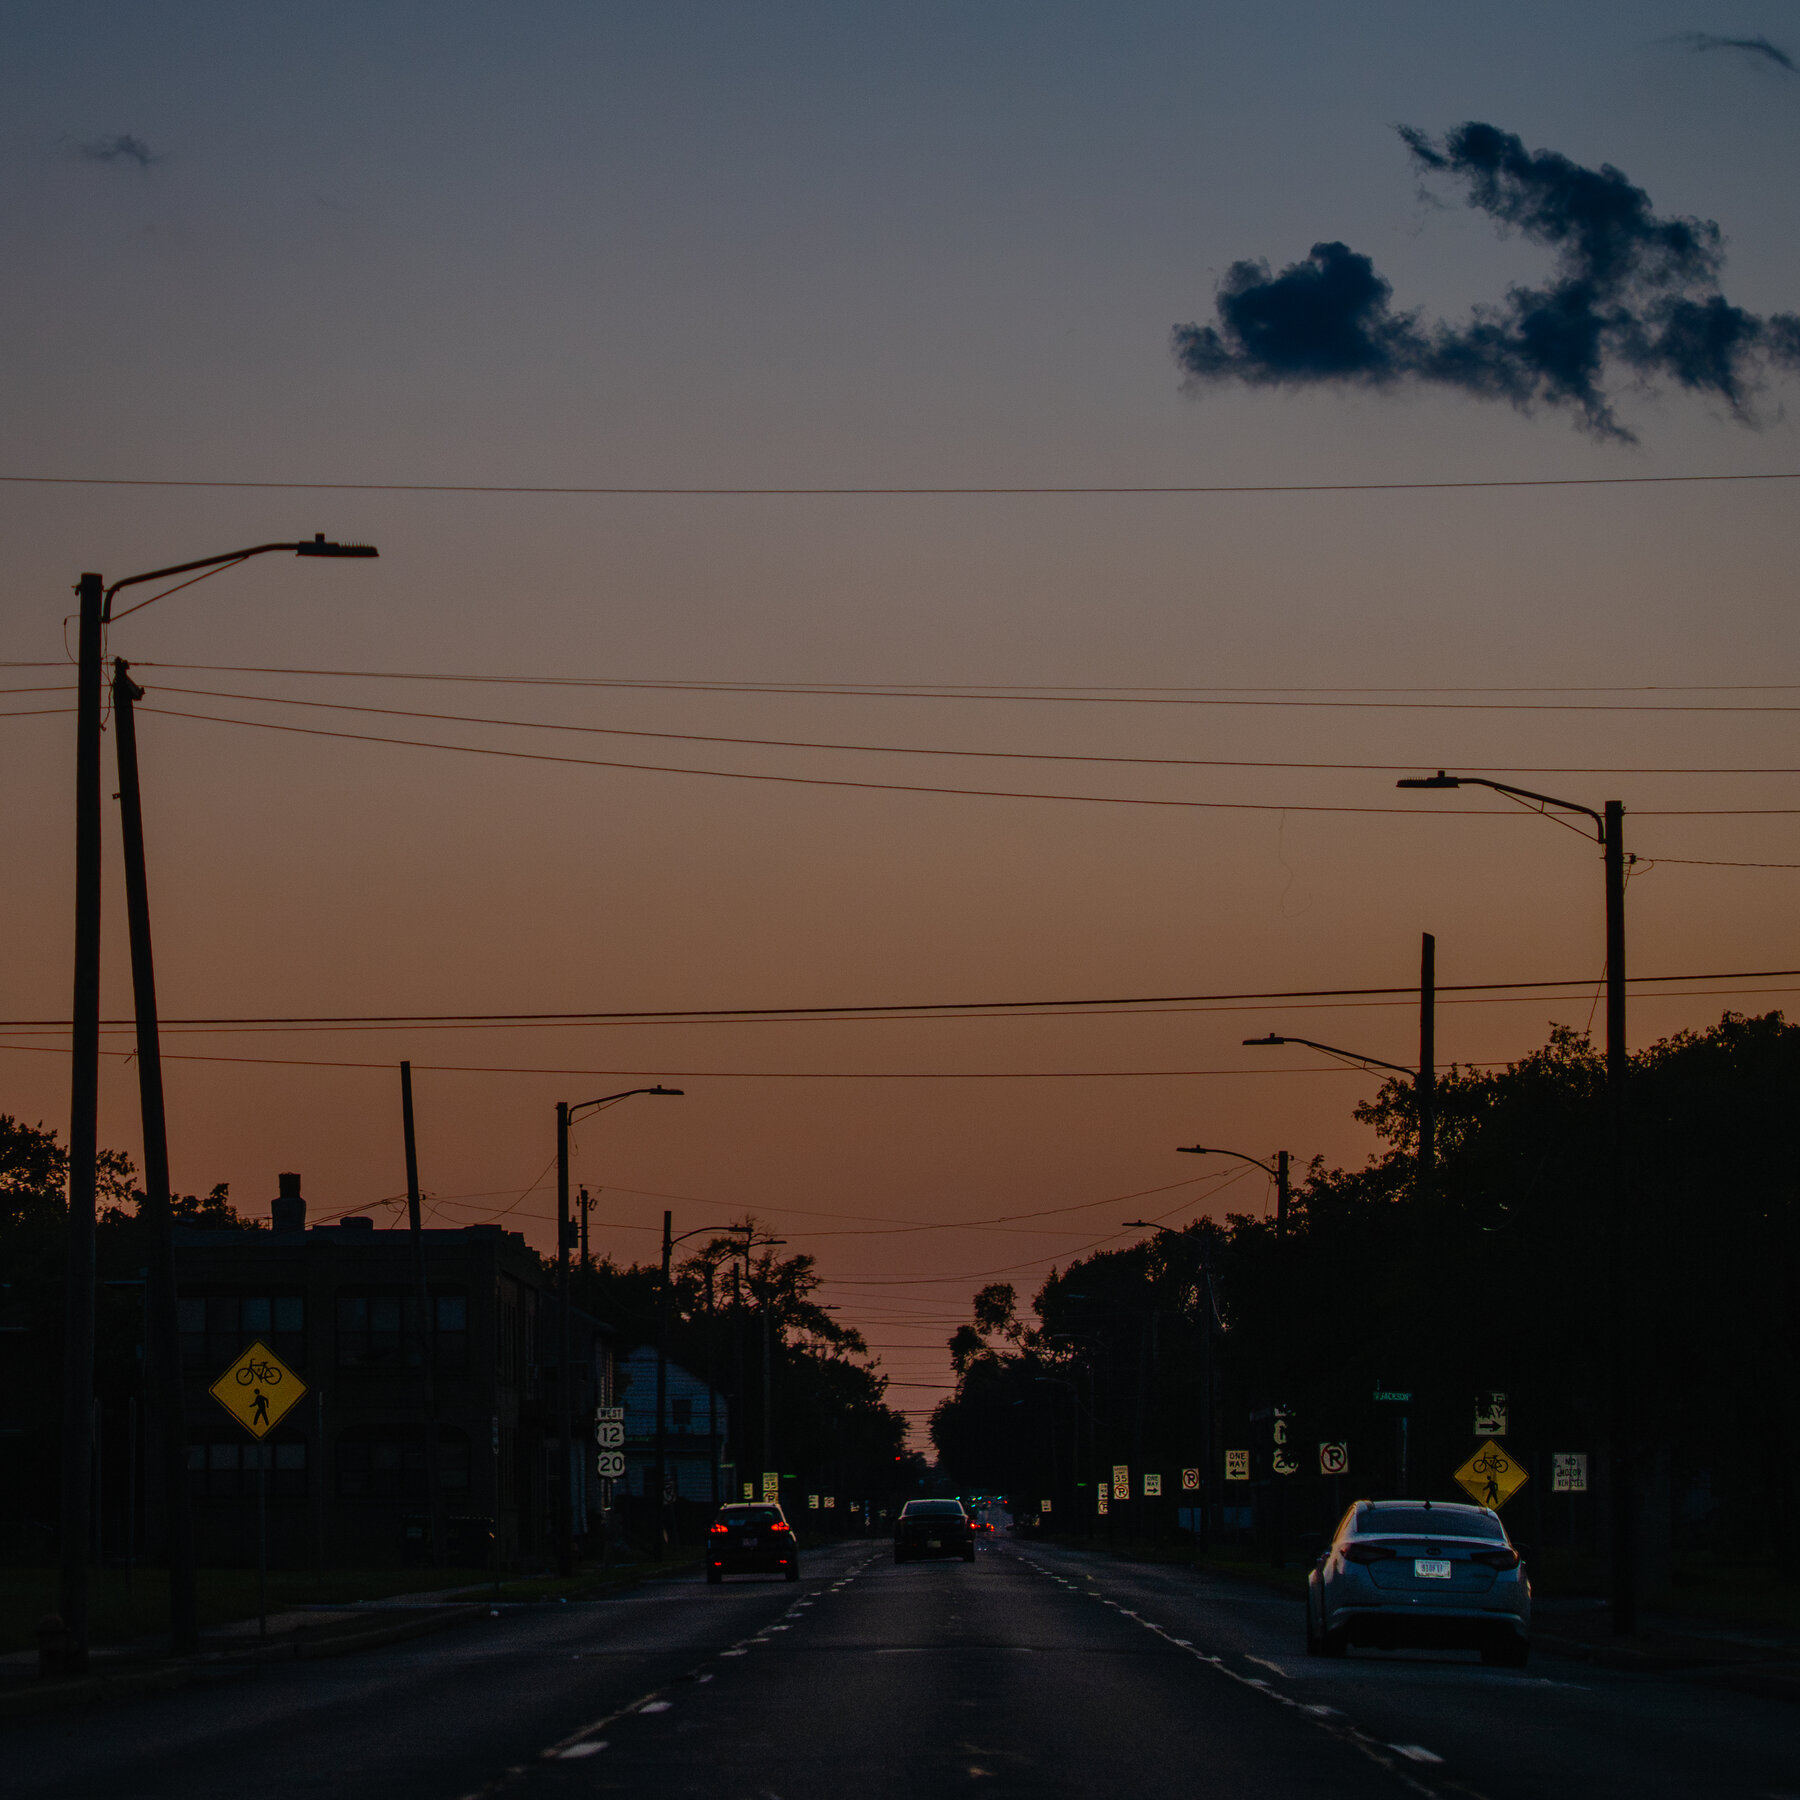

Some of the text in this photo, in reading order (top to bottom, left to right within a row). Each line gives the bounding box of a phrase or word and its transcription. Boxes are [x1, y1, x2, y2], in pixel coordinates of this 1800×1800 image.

[600, 1409, 621, 1418] WEST
[602, 1427, 620, 1442] 12
[1229, 1452, 1247, 1460] ONE
[600, 1456, 622, 1471] 20
[1564, 1457, 1577, 1466] NO
[1559, 1468, 1582, 1477] MOTOR
[1115, 1474, 1128, 1483] 35
[1557, 1479, 1584, 1488] VEHICLES
